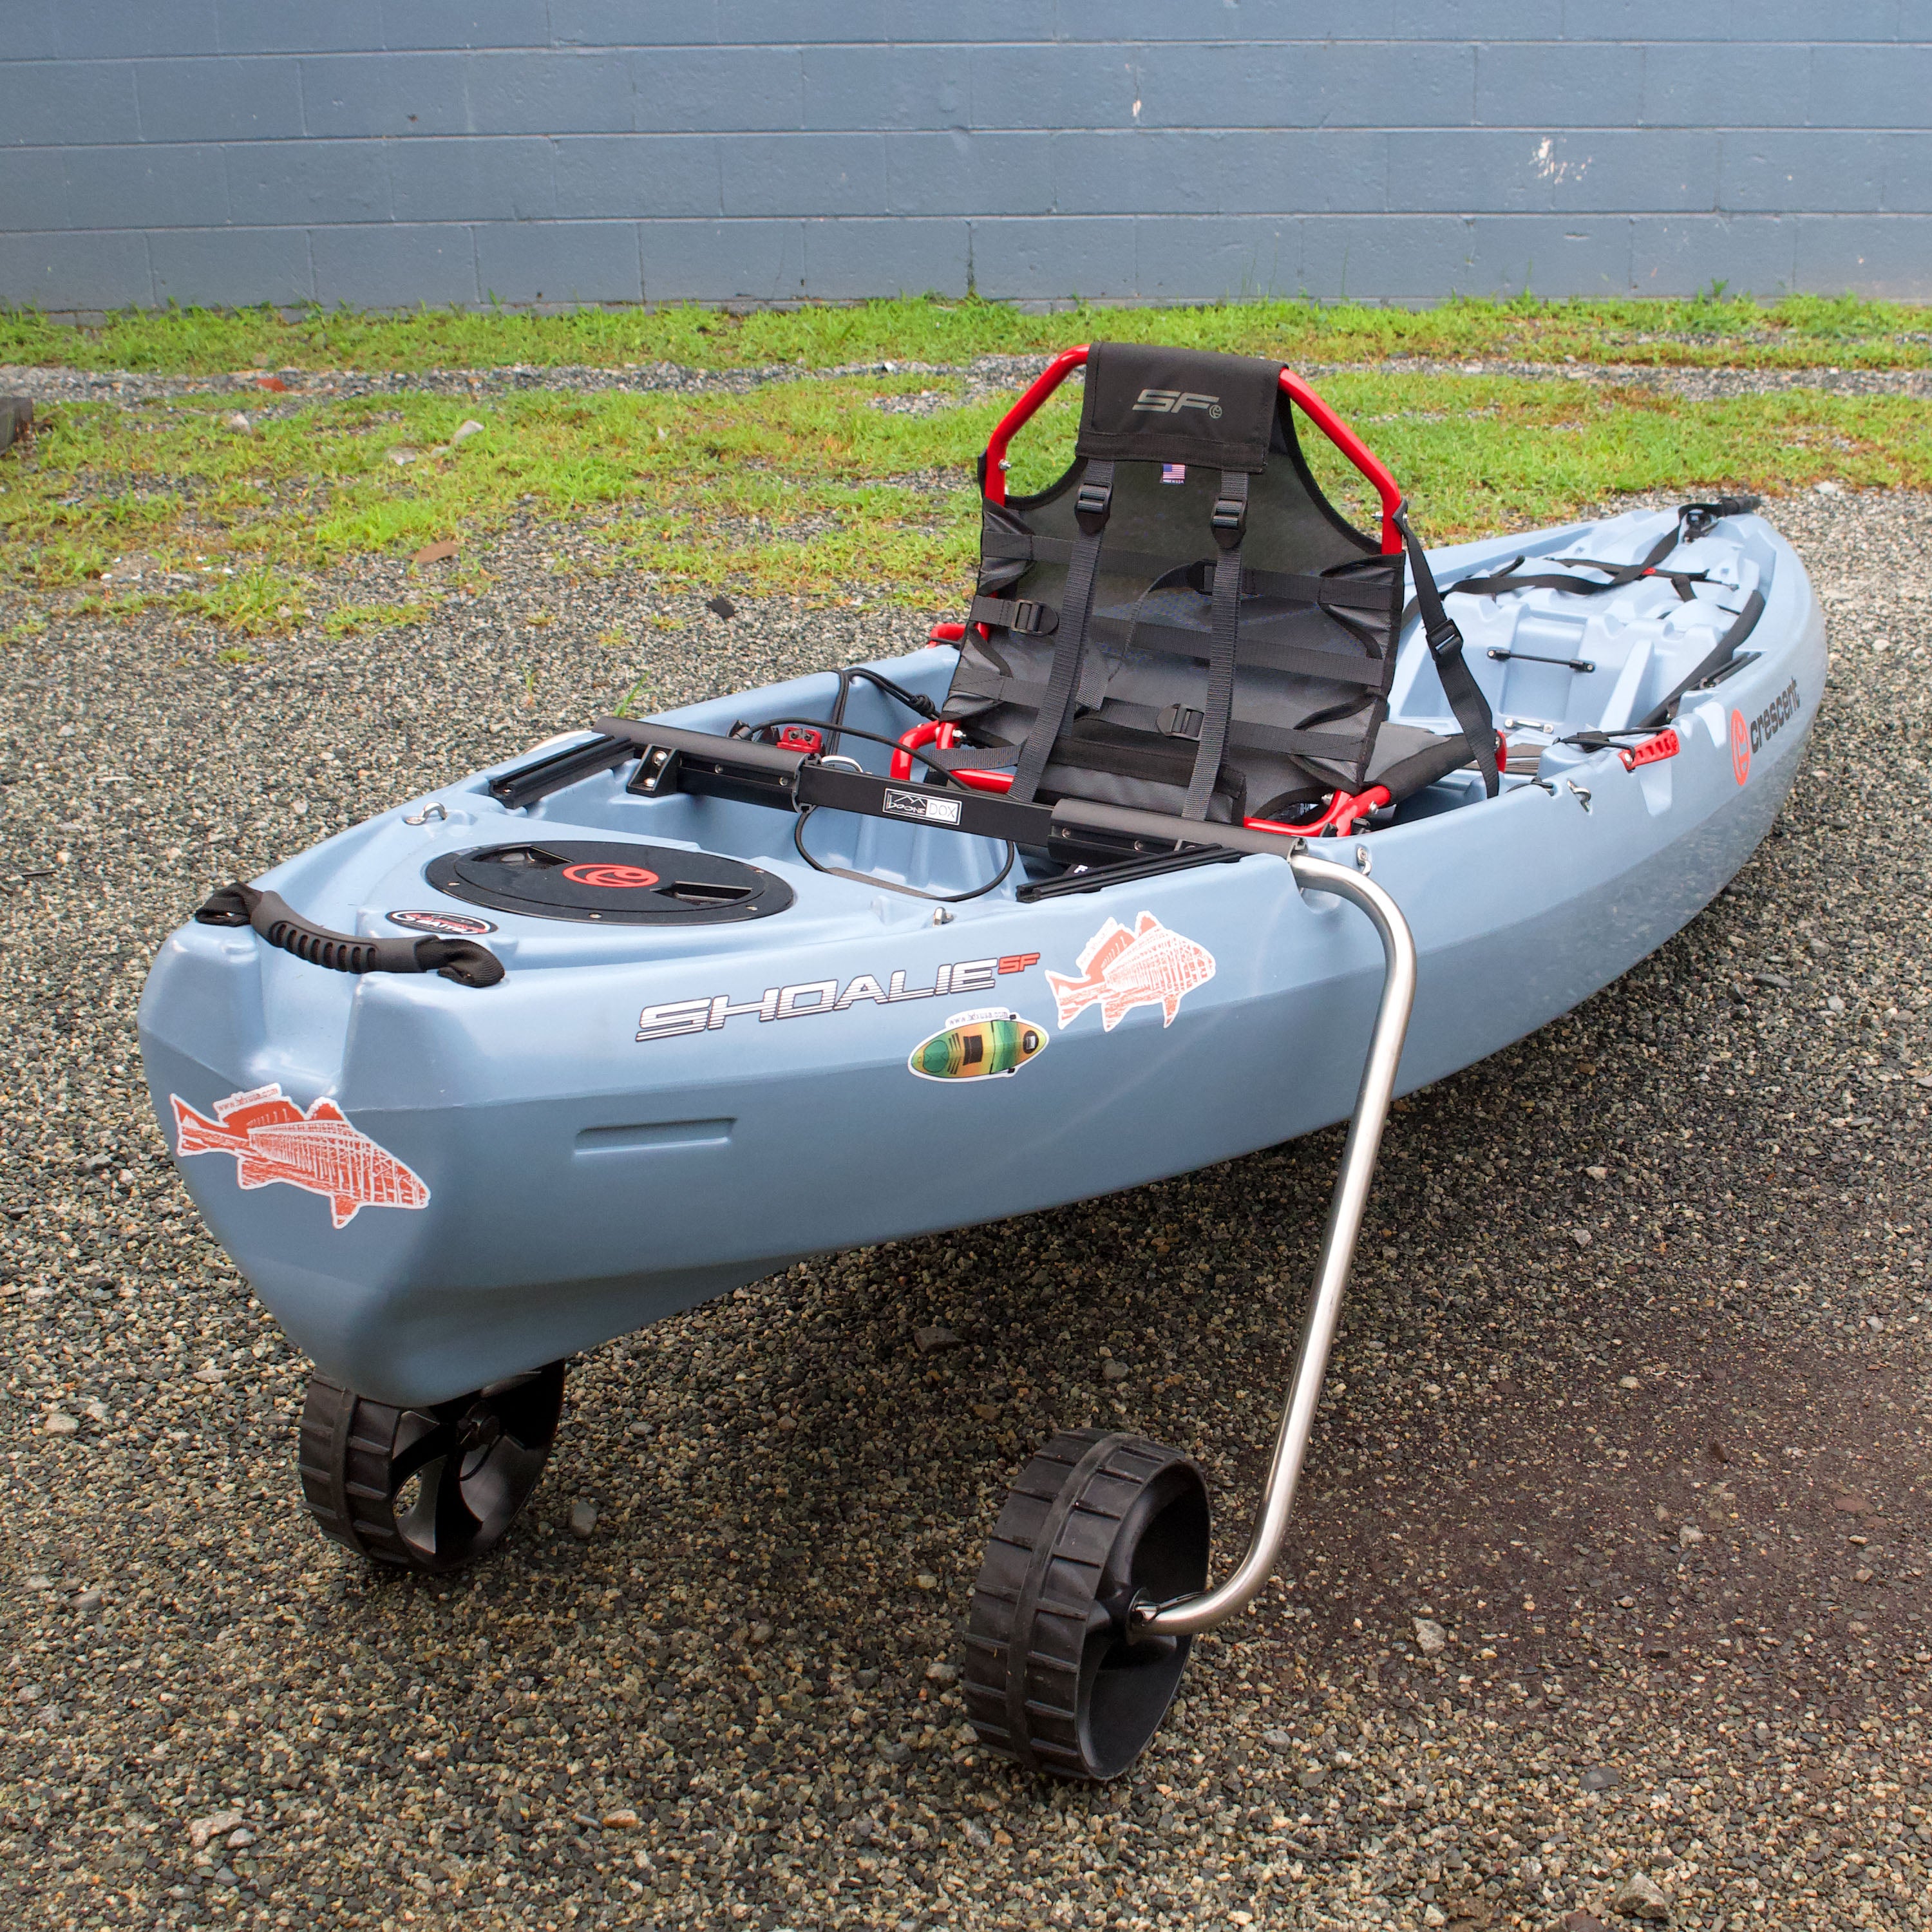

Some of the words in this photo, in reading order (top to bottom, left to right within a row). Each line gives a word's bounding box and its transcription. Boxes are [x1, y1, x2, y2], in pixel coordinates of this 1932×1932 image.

[1132, 388, 1219, 413] SF
[1750, 676, 1801, 754] crescent
[929, 802, 956, 818] DOX
[636, 958, 998, 1042] SHOALIE
[998, 952, 1040, 975] SF
